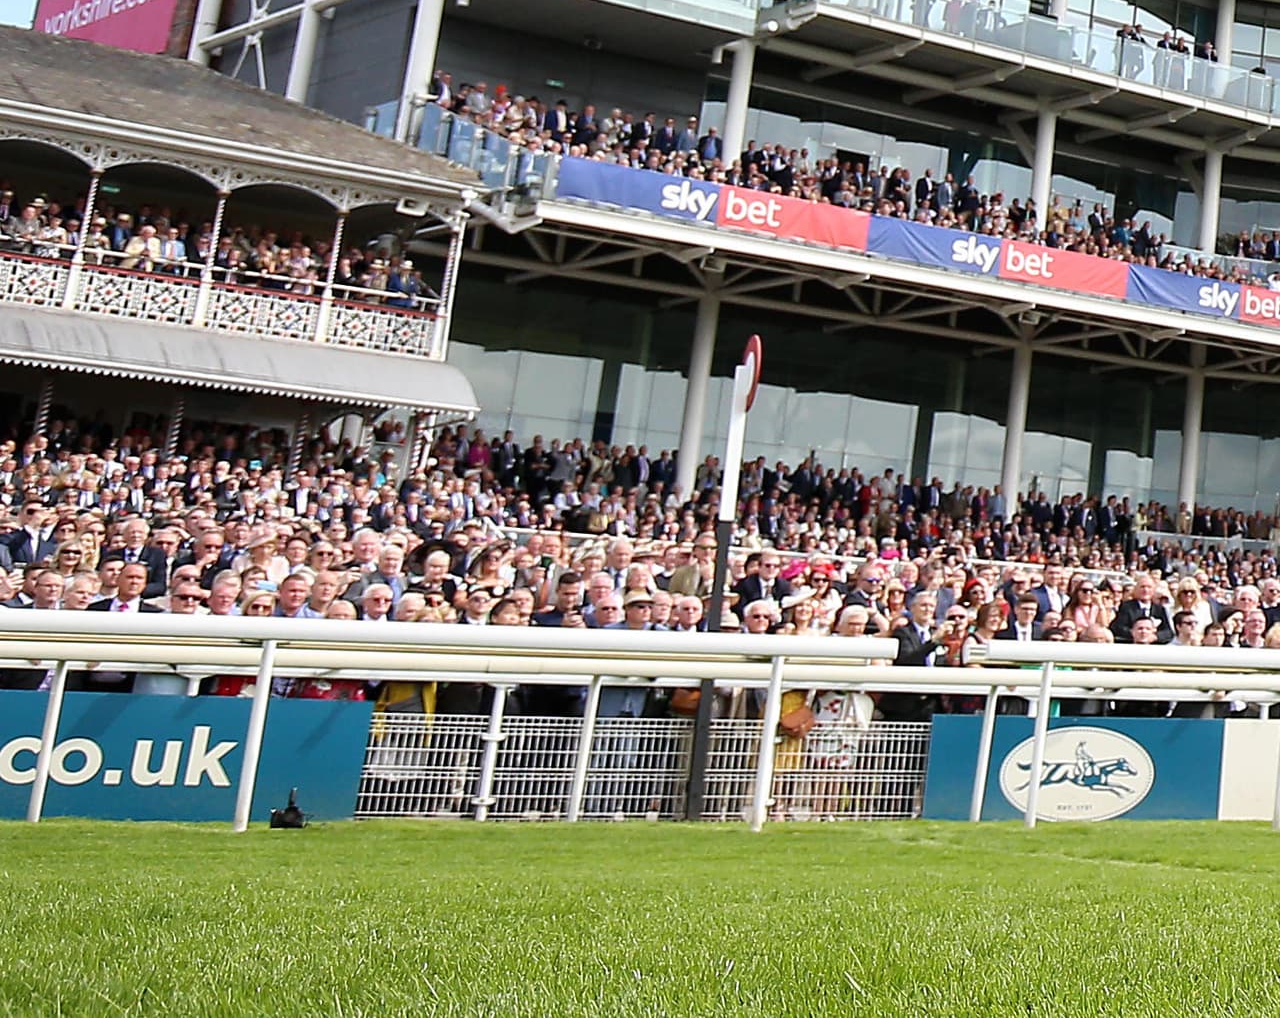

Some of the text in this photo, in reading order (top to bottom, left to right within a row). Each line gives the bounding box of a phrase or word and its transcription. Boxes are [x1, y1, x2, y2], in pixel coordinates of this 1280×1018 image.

[661, 181, 782, 227] sky bet
[951, 235, 1054, 278] sky bet
[1198, 282, 1240, 317] sky
